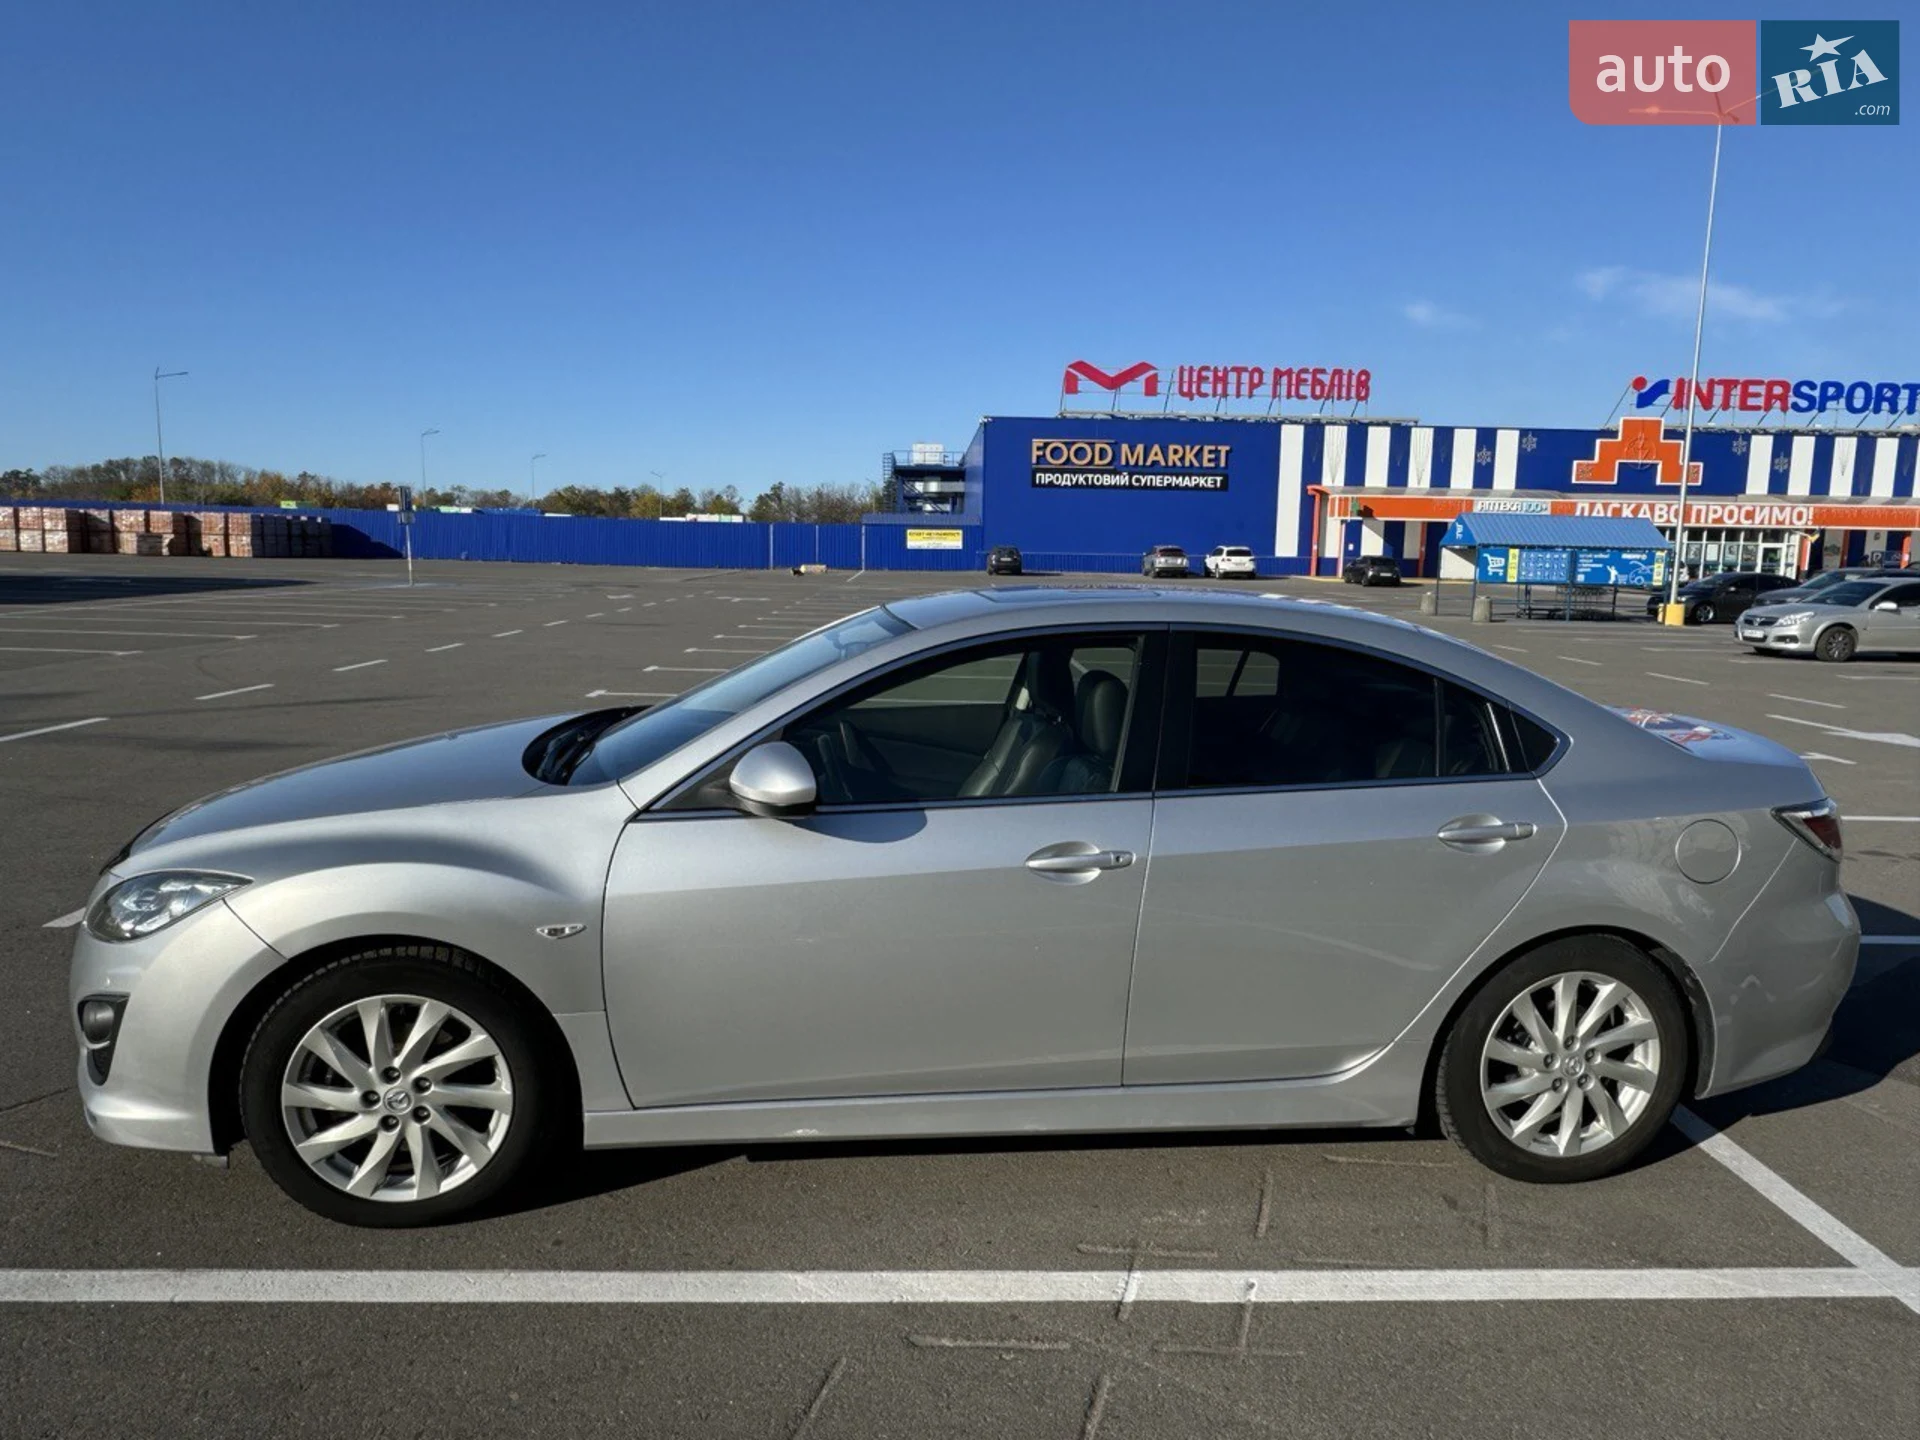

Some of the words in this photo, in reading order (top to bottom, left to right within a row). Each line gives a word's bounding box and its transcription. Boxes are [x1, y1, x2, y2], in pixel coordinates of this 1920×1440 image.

[1178, 366, 1264, 400] ЦЕНТР
[1271, 367, 1371, 402] МЕБЛІВ
[1672, 377, 1920, 415] INTERSPORT
[1031, 442, 1112, 466] FOOD
[1120, 444, 1229, 468] MARKET
[1034, 472, 1129, 487] ПРОДУКТОВИЙ
[1132, 474, 1223, 488] СУПЕРМАРКЕТ
[1691, 504, 1815, 526] ПРОСИМО!
